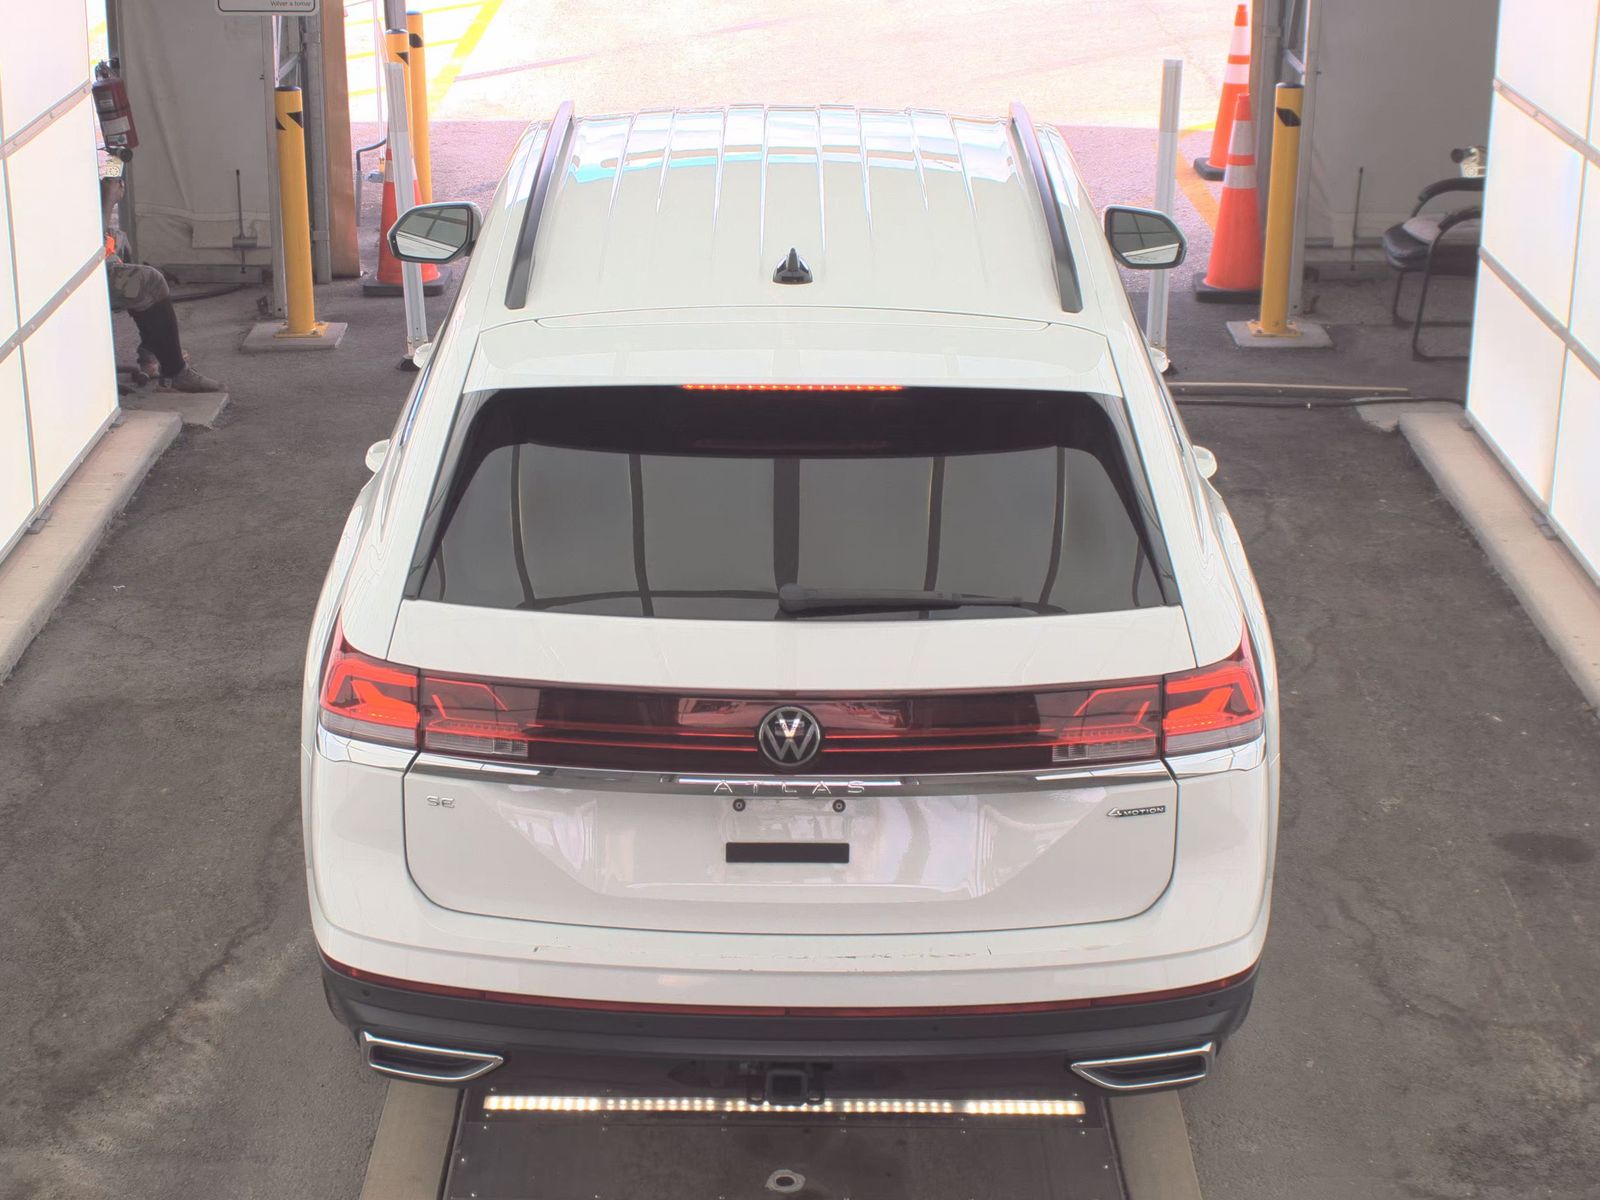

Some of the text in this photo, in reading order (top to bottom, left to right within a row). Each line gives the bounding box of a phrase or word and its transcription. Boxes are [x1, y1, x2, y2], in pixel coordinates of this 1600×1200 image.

[713, 780, 865, 795] ATLAS
[426, 795, 455, 809] SE
[1107, 806, 1165, 817] 4MOTION
